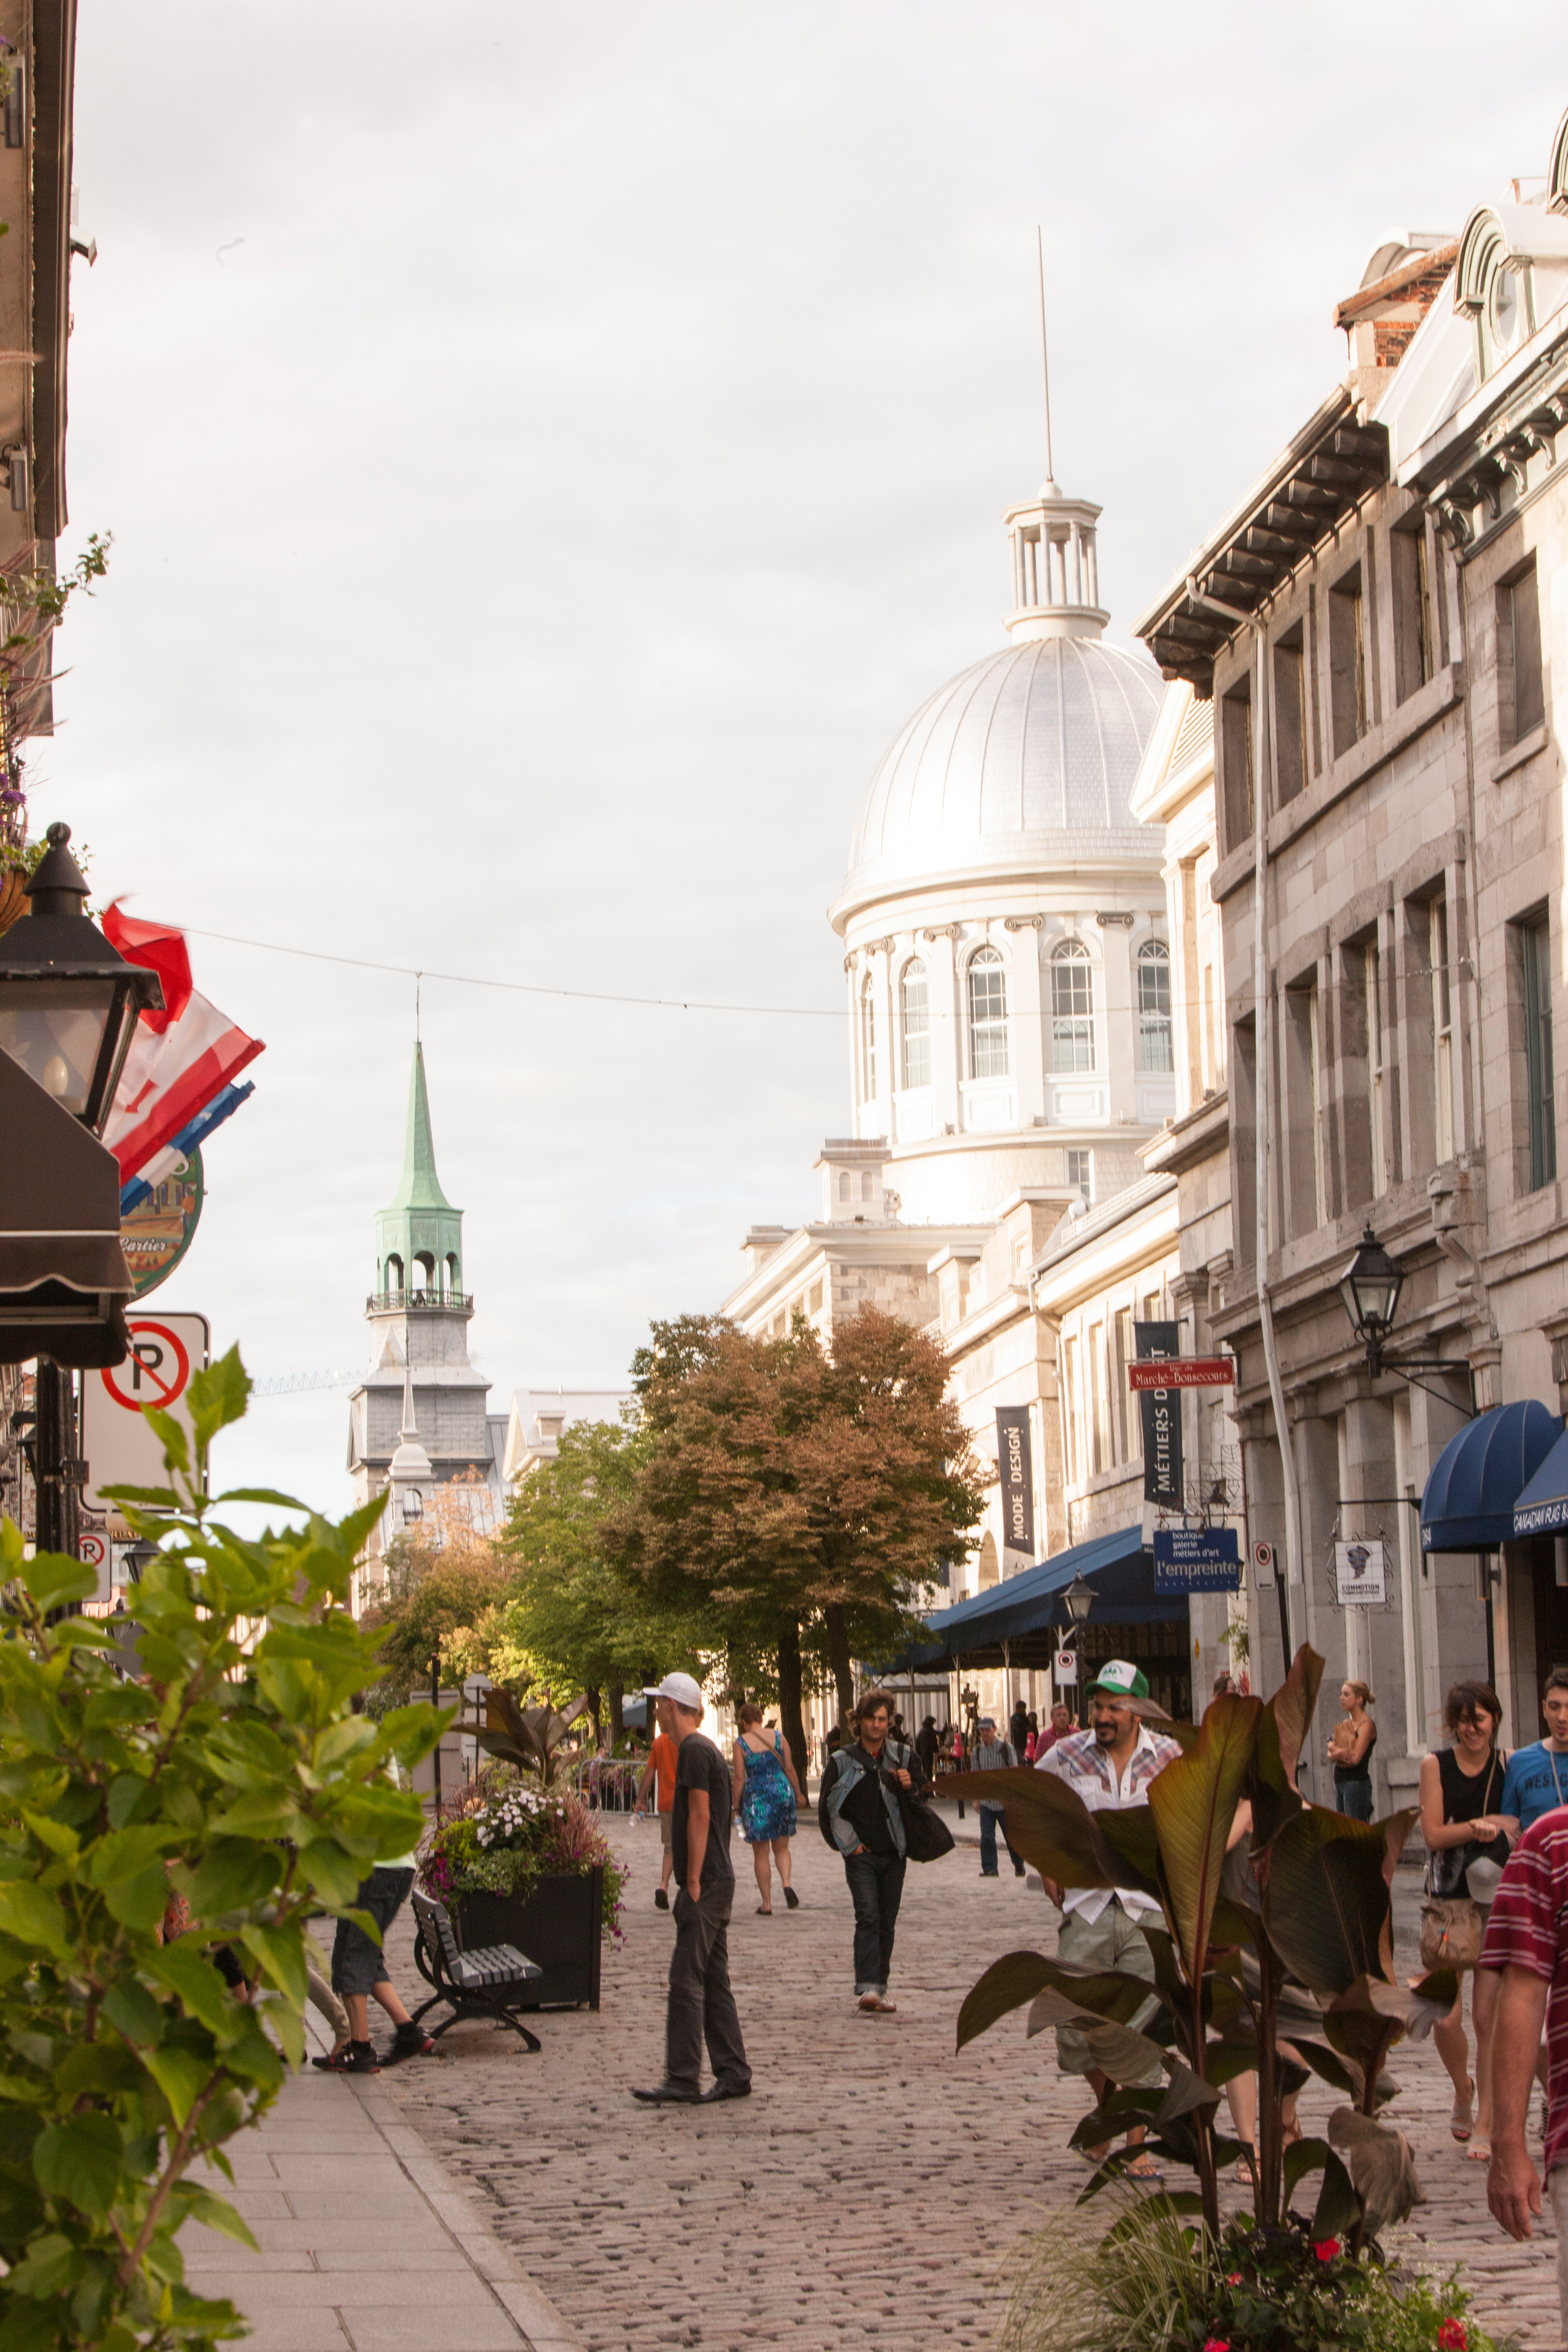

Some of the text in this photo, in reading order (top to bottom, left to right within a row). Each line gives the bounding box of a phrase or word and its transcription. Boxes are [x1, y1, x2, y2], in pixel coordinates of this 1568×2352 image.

[133, 1343, 163, 1390] P
[1185, 1363, 1193, 1372] du
[1135, 1371, 1228, 1386] Marché-Bonsecours
[1155, 1407, 1170, 1492] MÉTIERS
[1008, 1427, 1024, 1540] MODE DESIGN
[1514, 1508, 1545, 1532] CANADIAN
[1545, 1504, 1560, 1524] RAG
[1173, 1531, 1204, 1540] boutique
[1173, 1540, 1198, 1550] galerie
[1173, 1548, 1220, 1558] métiers d'art
[1157, 1558, 1236, 1580] l'empreinte
